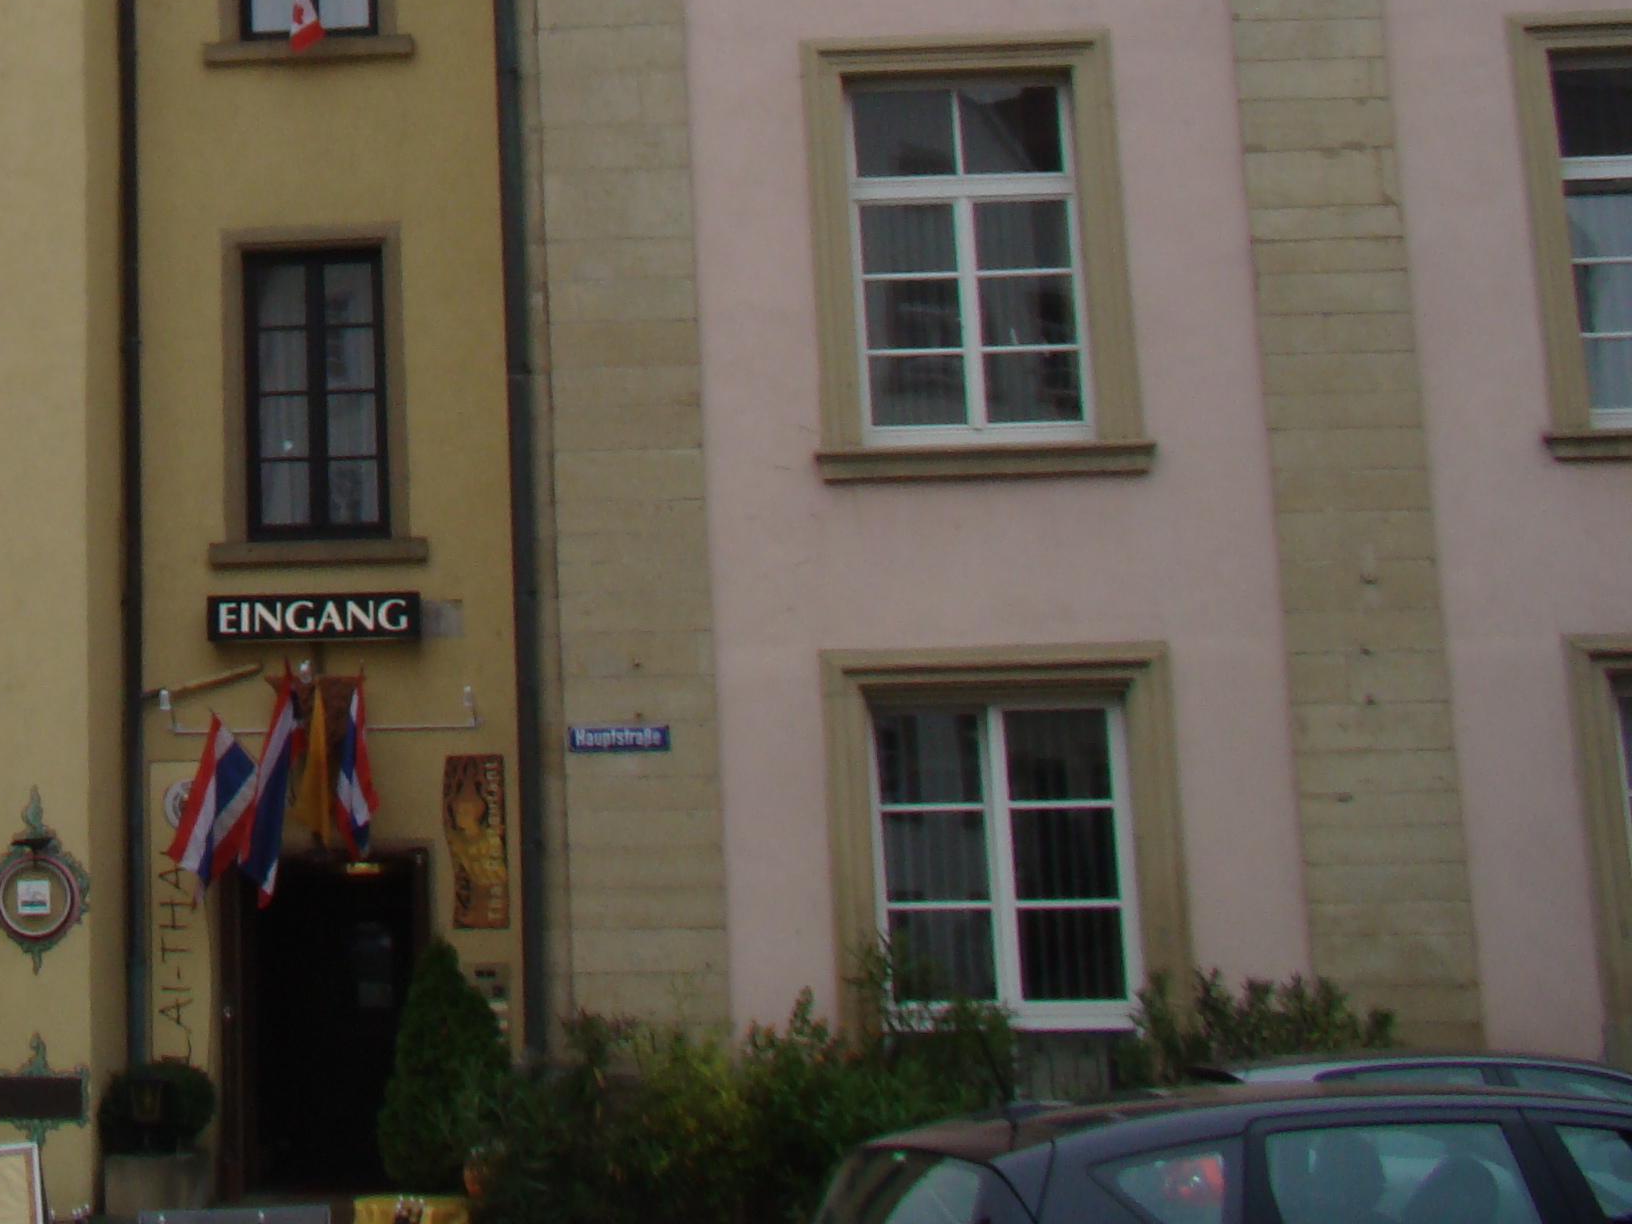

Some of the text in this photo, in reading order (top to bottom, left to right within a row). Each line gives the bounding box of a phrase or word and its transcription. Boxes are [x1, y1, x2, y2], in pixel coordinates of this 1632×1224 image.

[217, 597, 409, 634] EINGANG
[574, 727, 663, 750] Hauptstraße
[156, 851, 197, 1065] LAI-THA
